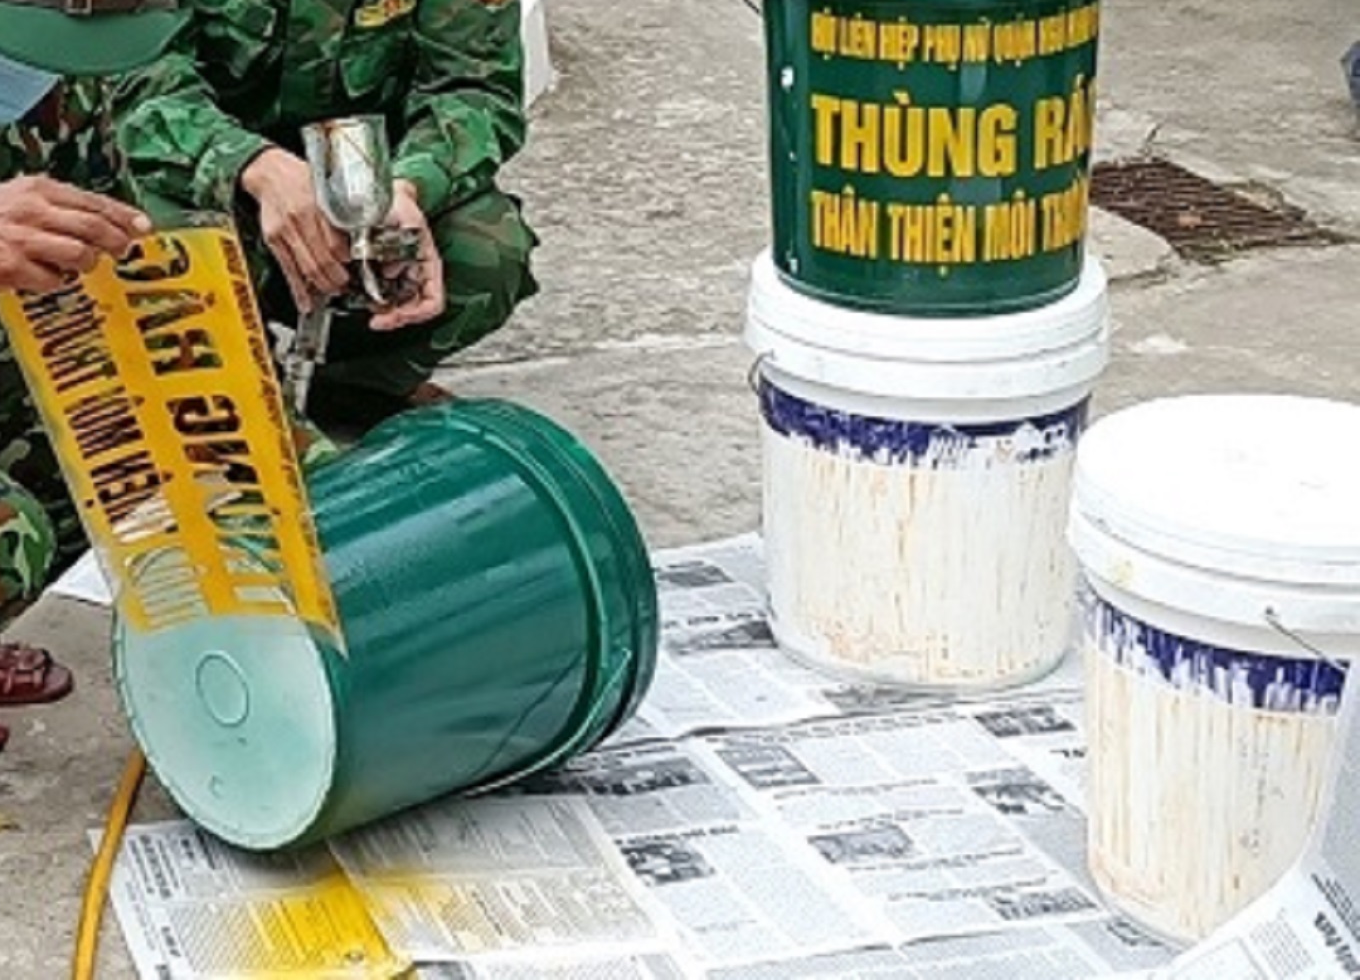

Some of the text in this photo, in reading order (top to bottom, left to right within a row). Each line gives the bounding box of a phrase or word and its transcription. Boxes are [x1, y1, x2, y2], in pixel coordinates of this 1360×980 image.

[879, 16, 920, 71] HIỆP
[810, 73, 1097, 178] THÙNG RÁ
[810, 183, 879, 260] THÂN
[887, 191, 976, 276] THIỆN
[983, 188, 1036, 262] MÔI
